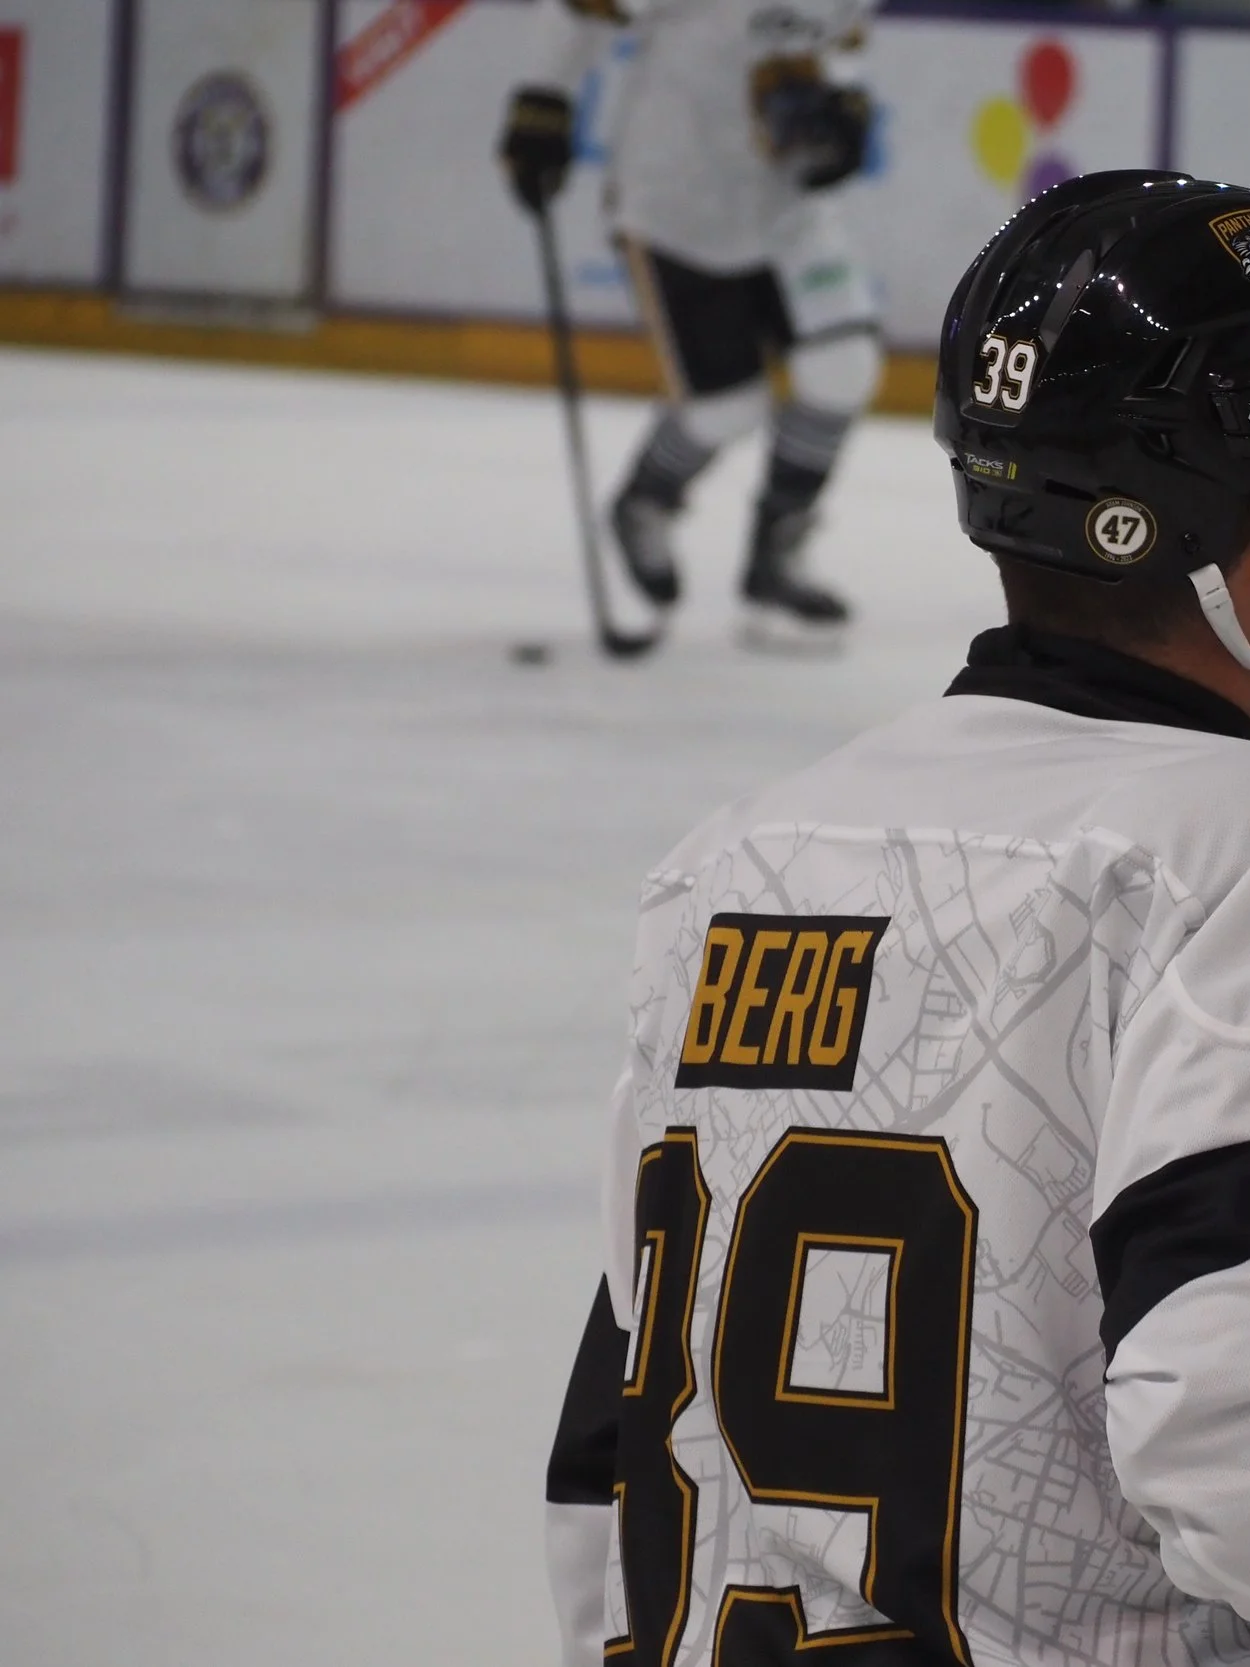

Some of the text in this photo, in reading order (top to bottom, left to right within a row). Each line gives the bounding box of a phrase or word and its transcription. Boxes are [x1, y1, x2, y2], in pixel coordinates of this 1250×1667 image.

[974, 334, 1038, 414] 39
[964, 452, 1004, 470] TACKS
[1101, 514, 1141, 546] 47
[681, 927, 874, 1066] BERG
